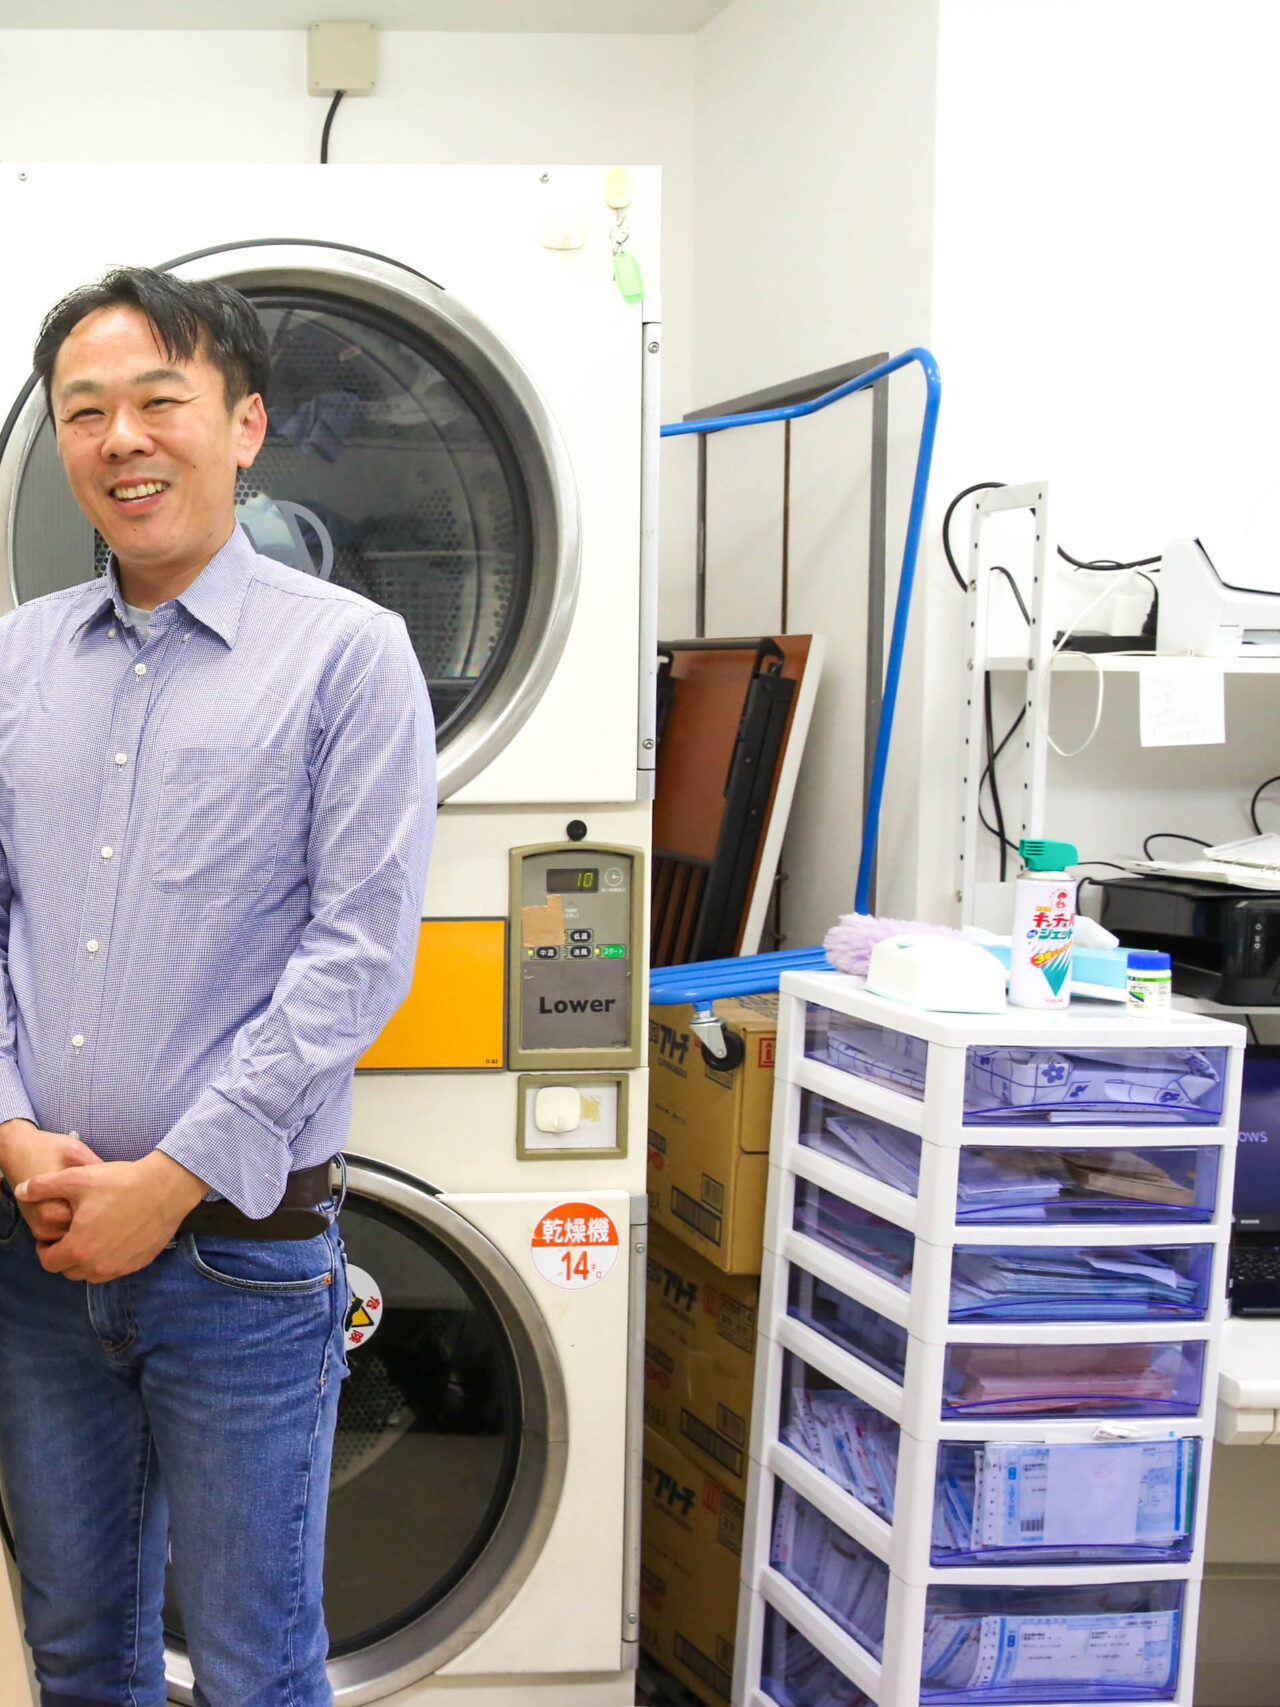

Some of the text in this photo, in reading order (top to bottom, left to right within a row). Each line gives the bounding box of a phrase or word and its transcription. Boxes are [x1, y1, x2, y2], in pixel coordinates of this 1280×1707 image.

[578, 872, 594, 887] 10
[1038, 928, 1072, 940] ジェット
[540, 996, 616, 1014] Lower
[542, 1218, 610, 1243] 乾燥機
[561, 1250, 589, 1280] 14
